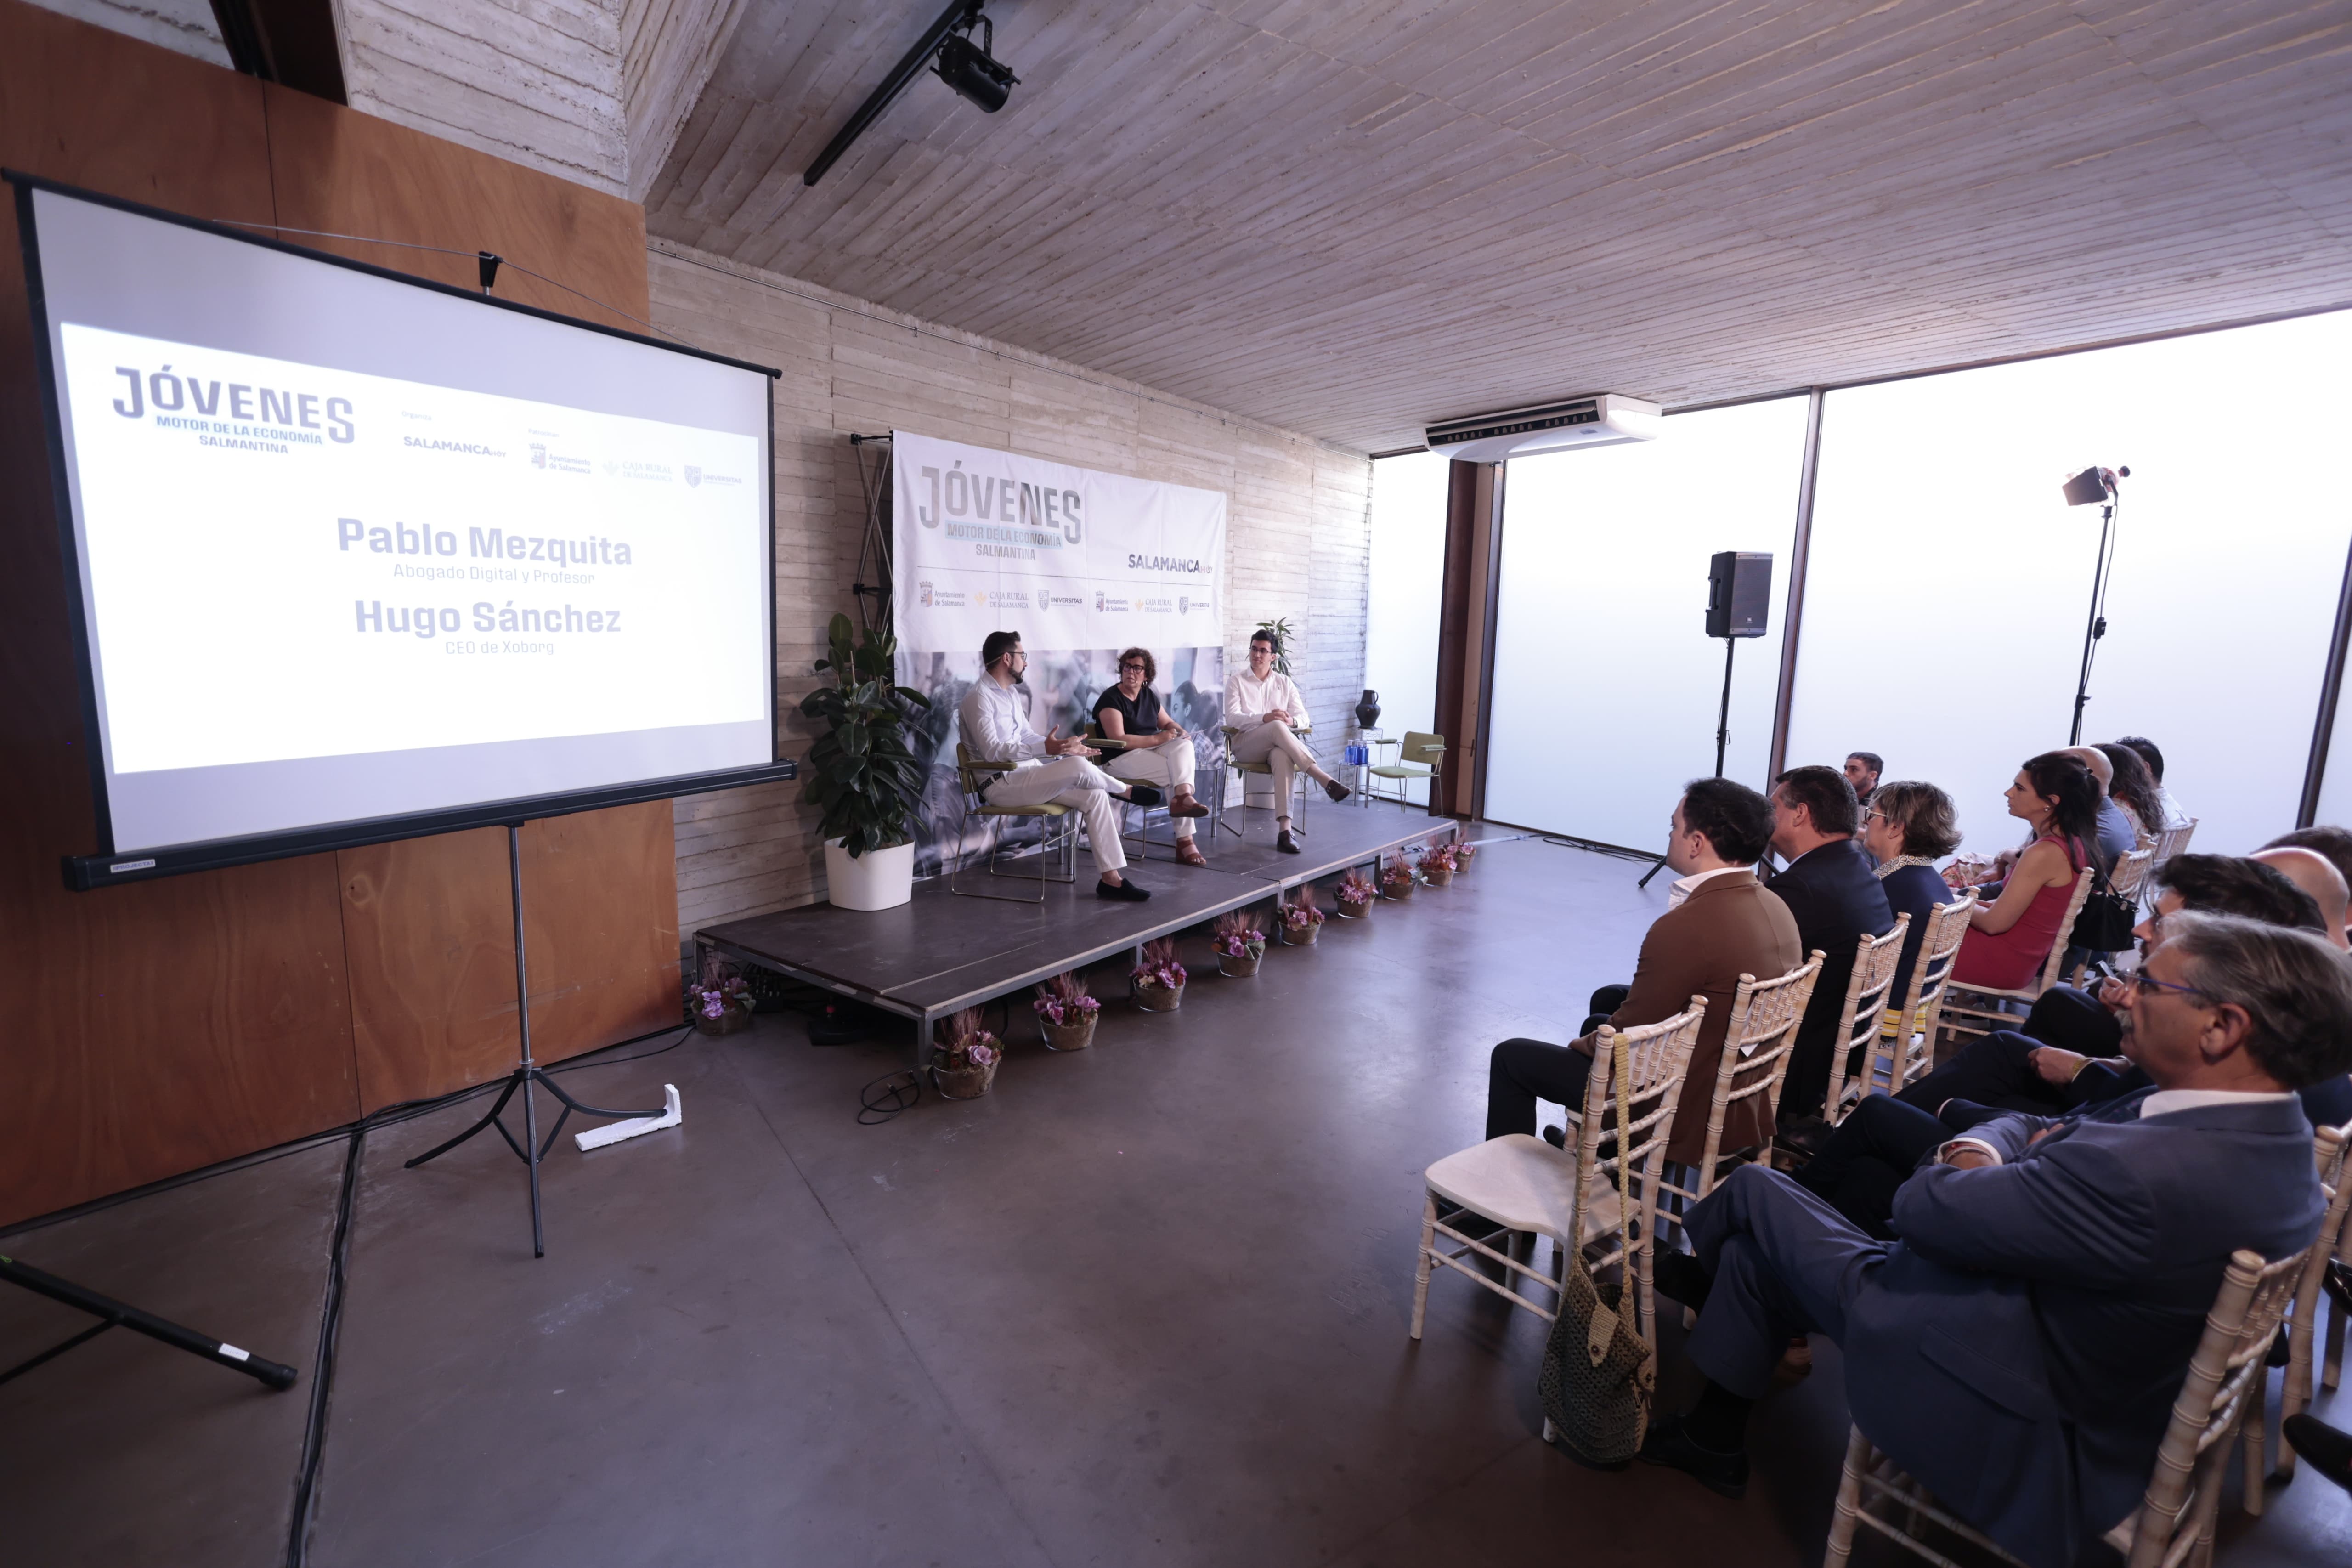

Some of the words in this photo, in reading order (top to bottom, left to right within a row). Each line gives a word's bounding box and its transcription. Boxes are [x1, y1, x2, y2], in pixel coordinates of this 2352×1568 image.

[113, 364, 355, 444] JÓVENES
[401, 410, 432, 421] Organiza
[156, 415, 209, 432] MOTOR
[213, 423, 230, 434] DE
[233, 425, 250, 436] LA
[253, 427, 322, 445] ECONOMÍA
[199, 435, 288, 454] SALMANTINA
[548, 453, 591, 466] Ayuntamiento
[559, 463, 591, 475] Salamanca
[622, 461, 644, 471] CAJA
[645, 463, 673, 474] RURAL
[703, 474, 742, 484] UNIVERSITAS
[919, 459, 1081, 544] JÓVENES
[337, 517, 457, 556] Pablo
[469, 526, 632, 568] Mezquita
[947, 523, 984, 539] MOTOR
[986, 527, 998, 540] DE
[1001, 529, 1012, 542] LA
[1014, 531, 1062, 547] ECONOMÍA
[976, 544, 1036, 560] SALMANTINA
[393, 563, 465, 581] Abogado
[469, 566, 517, 583] Digital
[521, 571, 529, 583] y
[533, 569, 595, 584] Profesor
[934, 590, 965, 599] Ayuntamiento
[989, 592, 1005, 601] CAJA
[1007, 592, 1029, 601] RURAL
[1145, 599, 1156, 607] CAJA
[355, 600, 461, 639] Hugo
[472, 600, 621, 633] Sánchez
[446, 641, 475, 655] CEO
[481, 641, 498, 653] de
[503, 640, 554, 655] Xoborg
